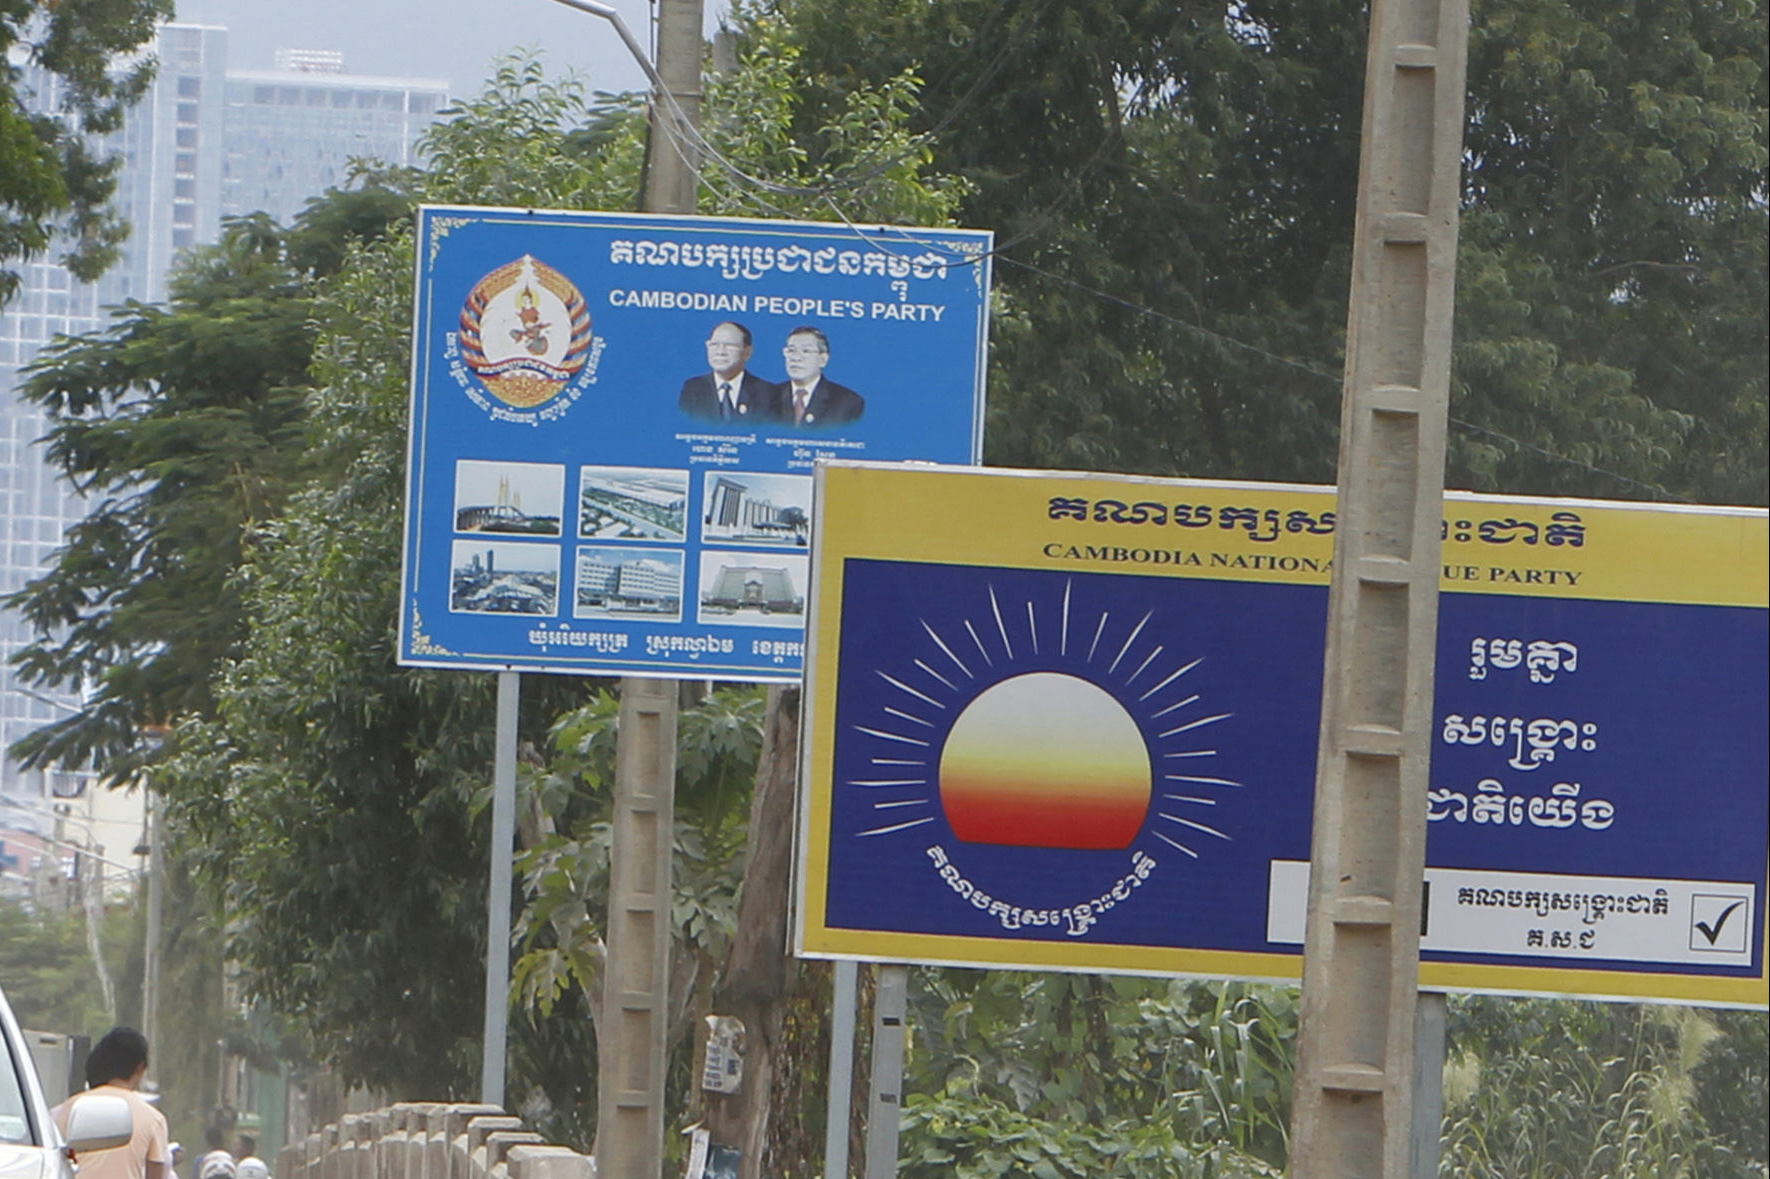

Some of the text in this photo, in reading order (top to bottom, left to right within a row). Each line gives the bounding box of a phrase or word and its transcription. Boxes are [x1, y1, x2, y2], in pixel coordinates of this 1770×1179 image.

[608, 289, 947, 322] CAMBODIAN PEOPLE'S PARTY
[1042, 542, 1201, 567] CAMBODIA
[1209, 553, 1334, 574] NATIONA
[1489, 567, 1584, 587] PARTY
[1468, 637, 1578, 684] រួមគ្នា
[1442, 714, 1598, 771] សង្គ្រោះ
[1456, 887, 1670, 925] គណបក្សសង្គ្រោះជាតិ
